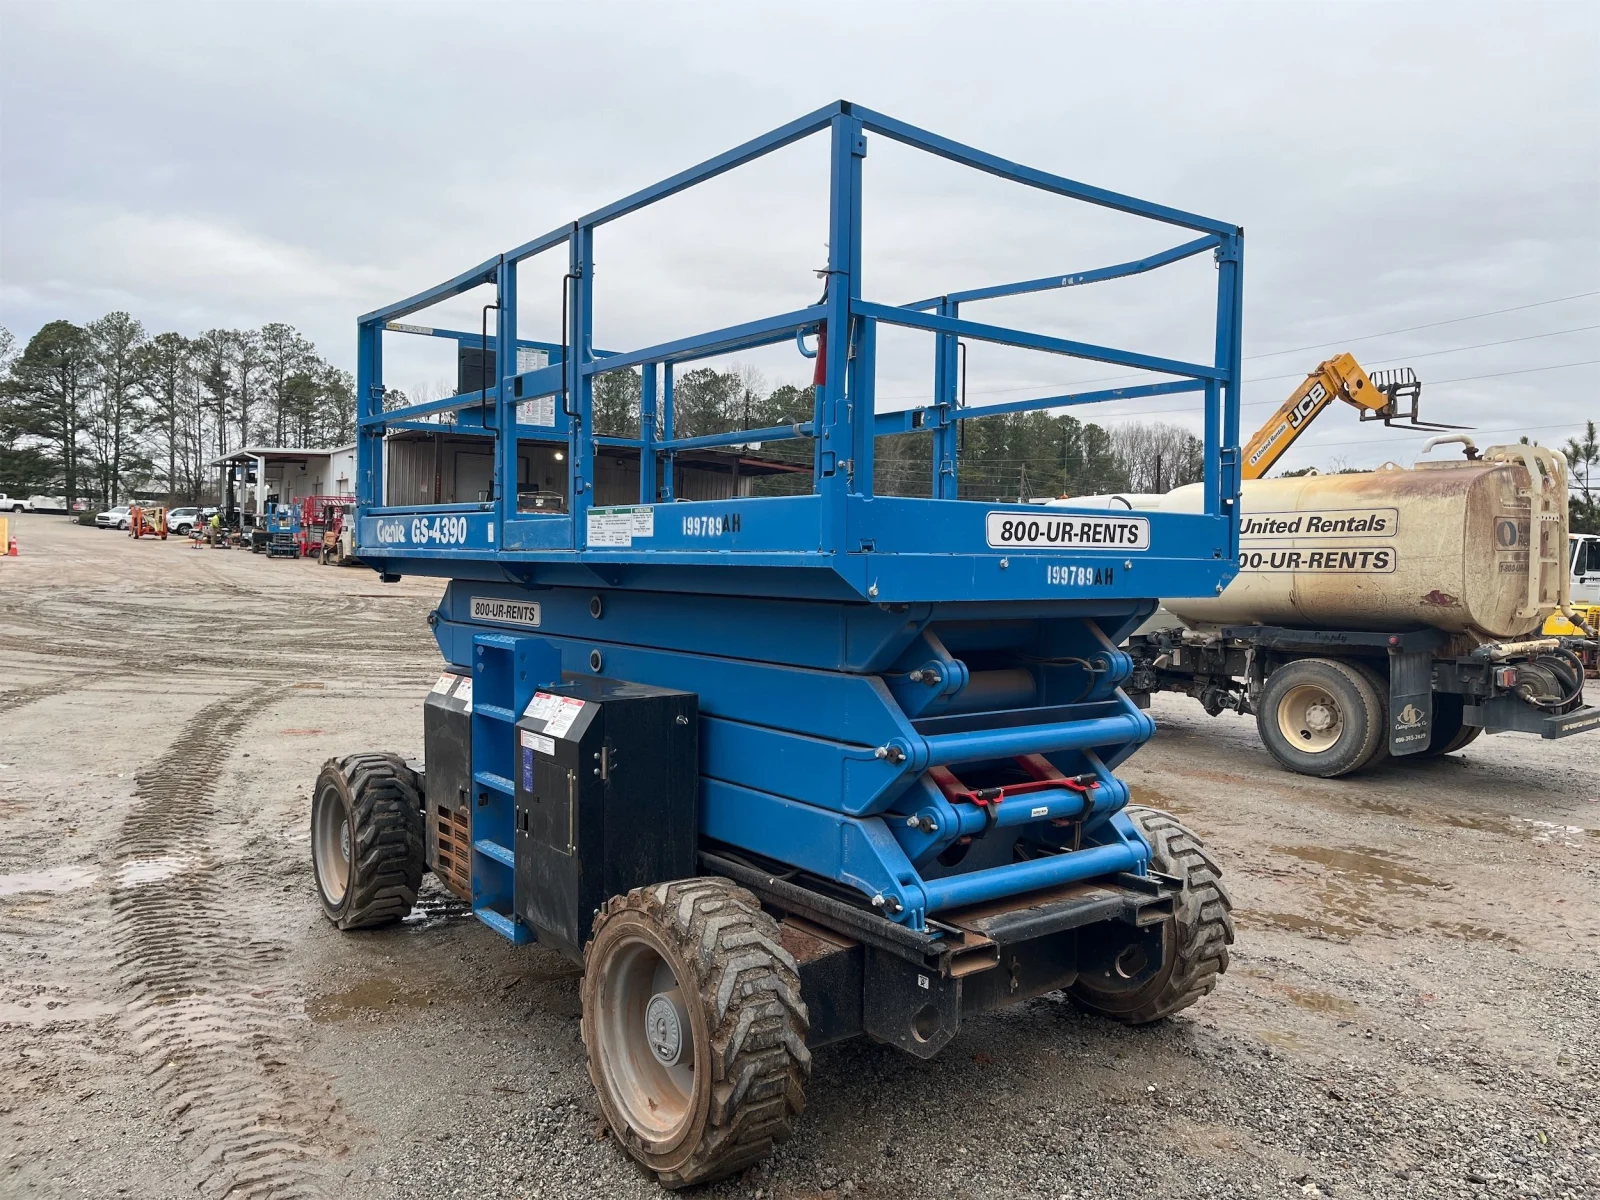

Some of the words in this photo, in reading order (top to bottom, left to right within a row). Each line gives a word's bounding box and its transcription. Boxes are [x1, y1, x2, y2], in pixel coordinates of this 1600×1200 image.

[1291, 382, 1326, 428] JCB
[1256, 440, 1271, 458] United
[1270, 424, 1286, 442] Rentals
[377, 519, 406, 543] Genie
[412, 516, 467, 544] GS-4390
[1001, 520, 1139, 544] 800-UR-RENTS
[1239, 516, 1302, 534] United
[1306, 514, 1387, 532] Rentals
[475, 603, 535, 621] 800-UR-RENTS
